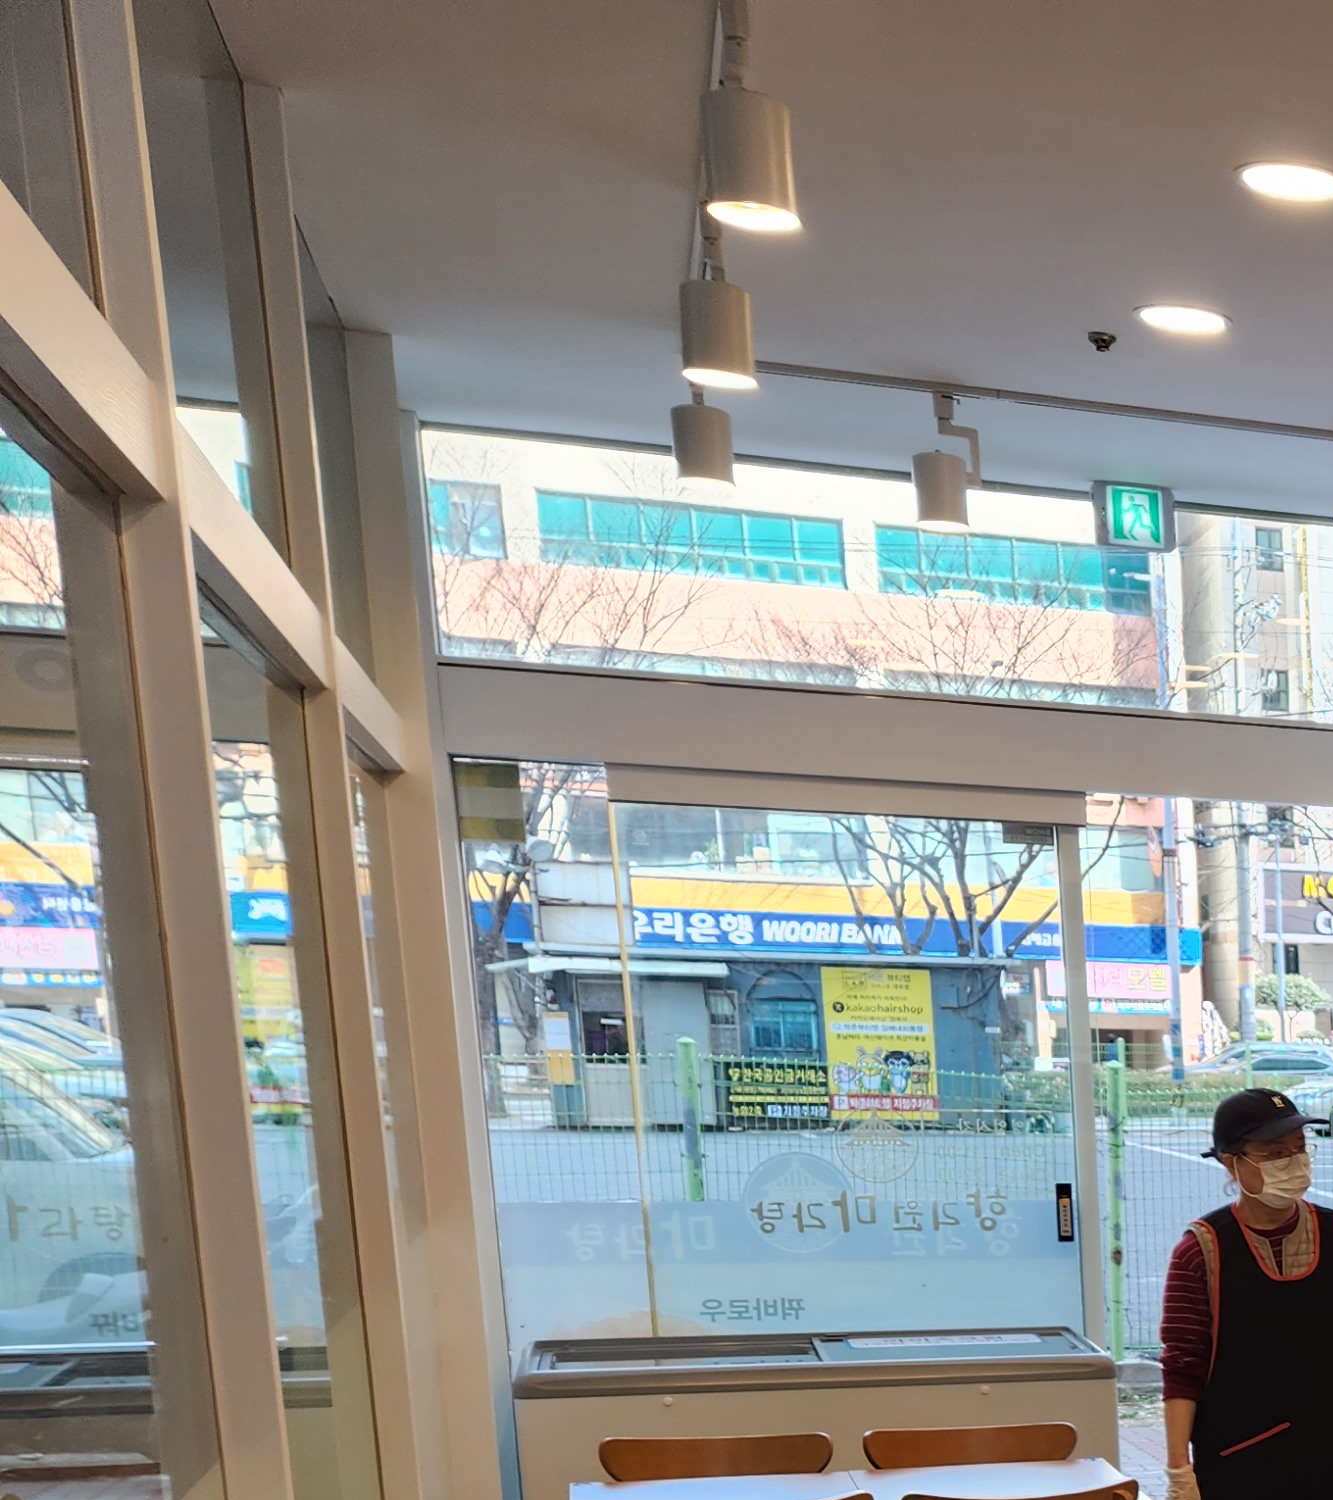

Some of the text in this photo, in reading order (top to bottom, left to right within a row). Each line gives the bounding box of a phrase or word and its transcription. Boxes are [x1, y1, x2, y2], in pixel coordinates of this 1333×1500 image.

[633, 911, 753, 945] 우리은행
[762, 919, 838, 943] WOORI
[1127, 967, 1167, 991] 모텔
[846, 1003, 923, 1015] kakaohairshop
